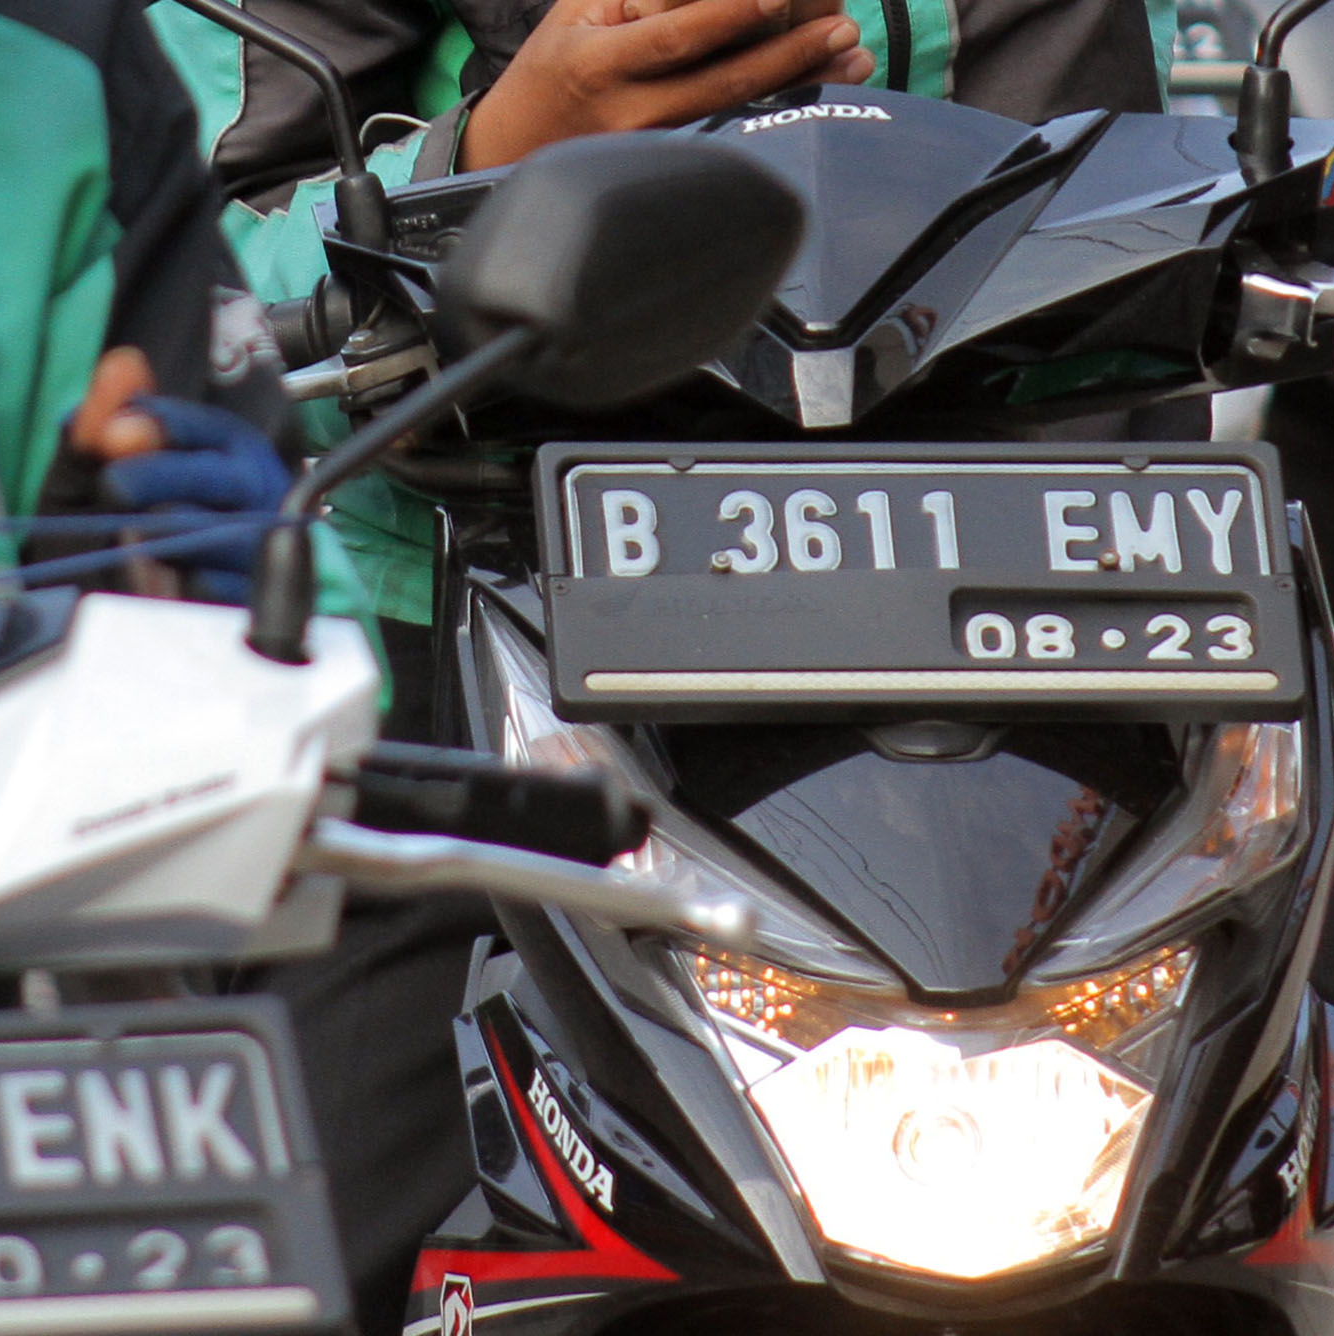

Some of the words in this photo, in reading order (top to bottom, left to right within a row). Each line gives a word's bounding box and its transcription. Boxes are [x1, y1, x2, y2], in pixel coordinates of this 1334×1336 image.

[742, 103, 893, 134] HONDA
[601, 489, 660, 577] B
[717, 489, 959, 574] 3611
[1044, 488, 1243, 575] EMY
[528, 1068, 614, 1213] HONDA
